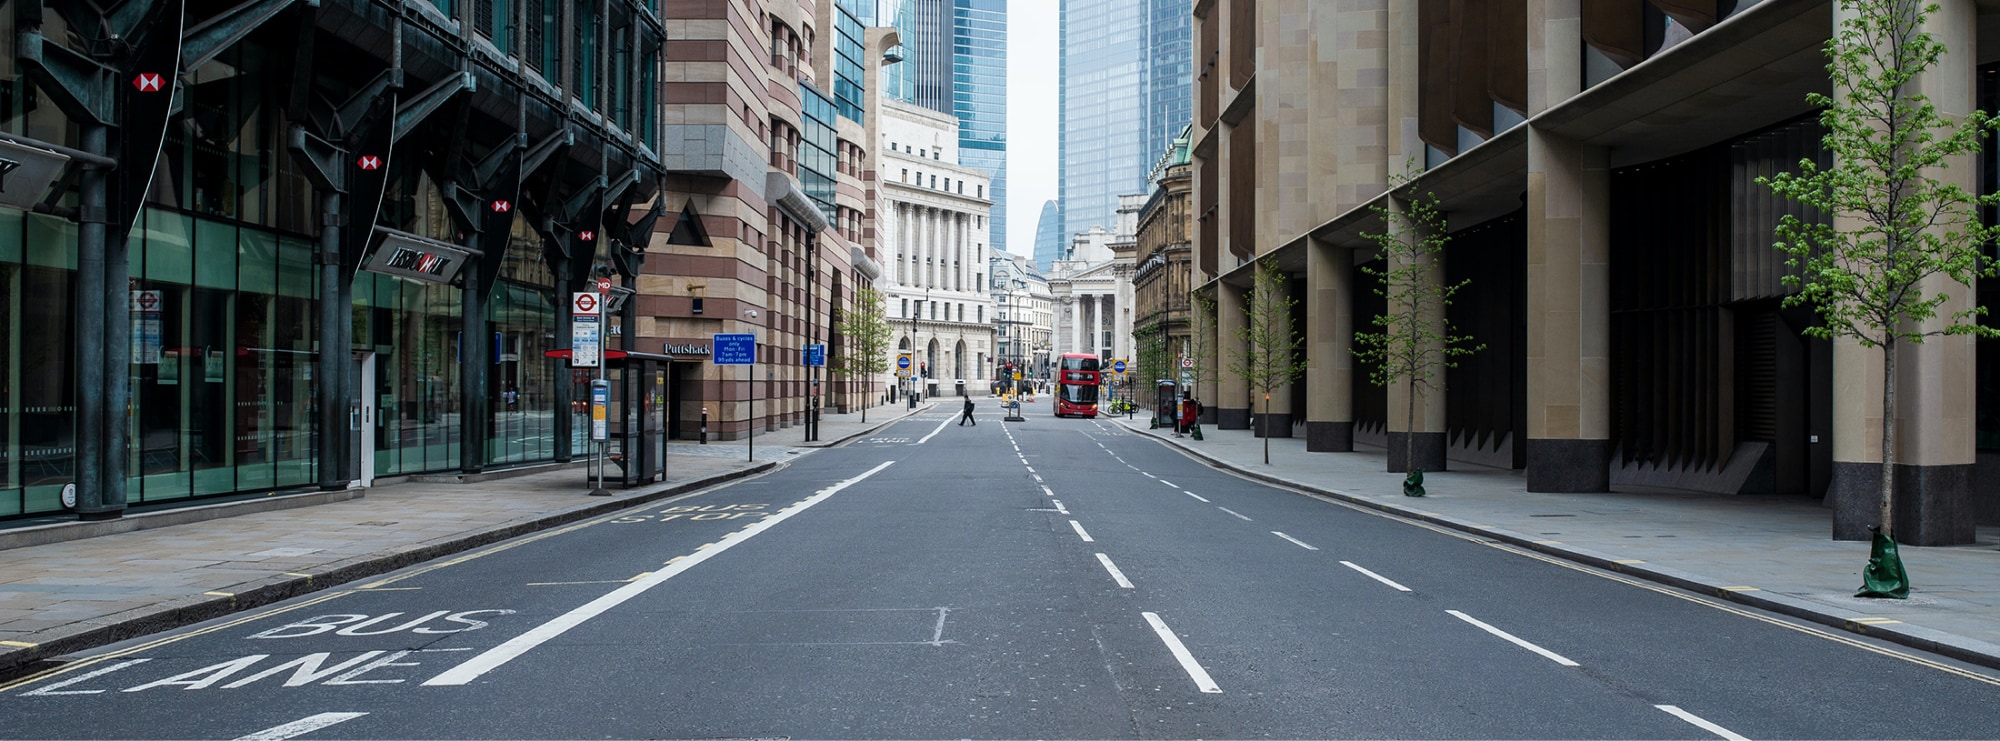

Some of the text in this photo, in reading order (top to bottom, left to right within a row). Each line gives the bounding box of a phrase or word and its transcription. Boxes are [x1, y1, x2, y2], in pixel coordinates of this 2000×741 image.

[664, 343, 710, 355] Puttshack
[659, 503, 770, 514] BUS
[610, 512, 770, 524] STOP
[245, 609, 517, 640] BUS
[15, 647, 474, 697] LANE
